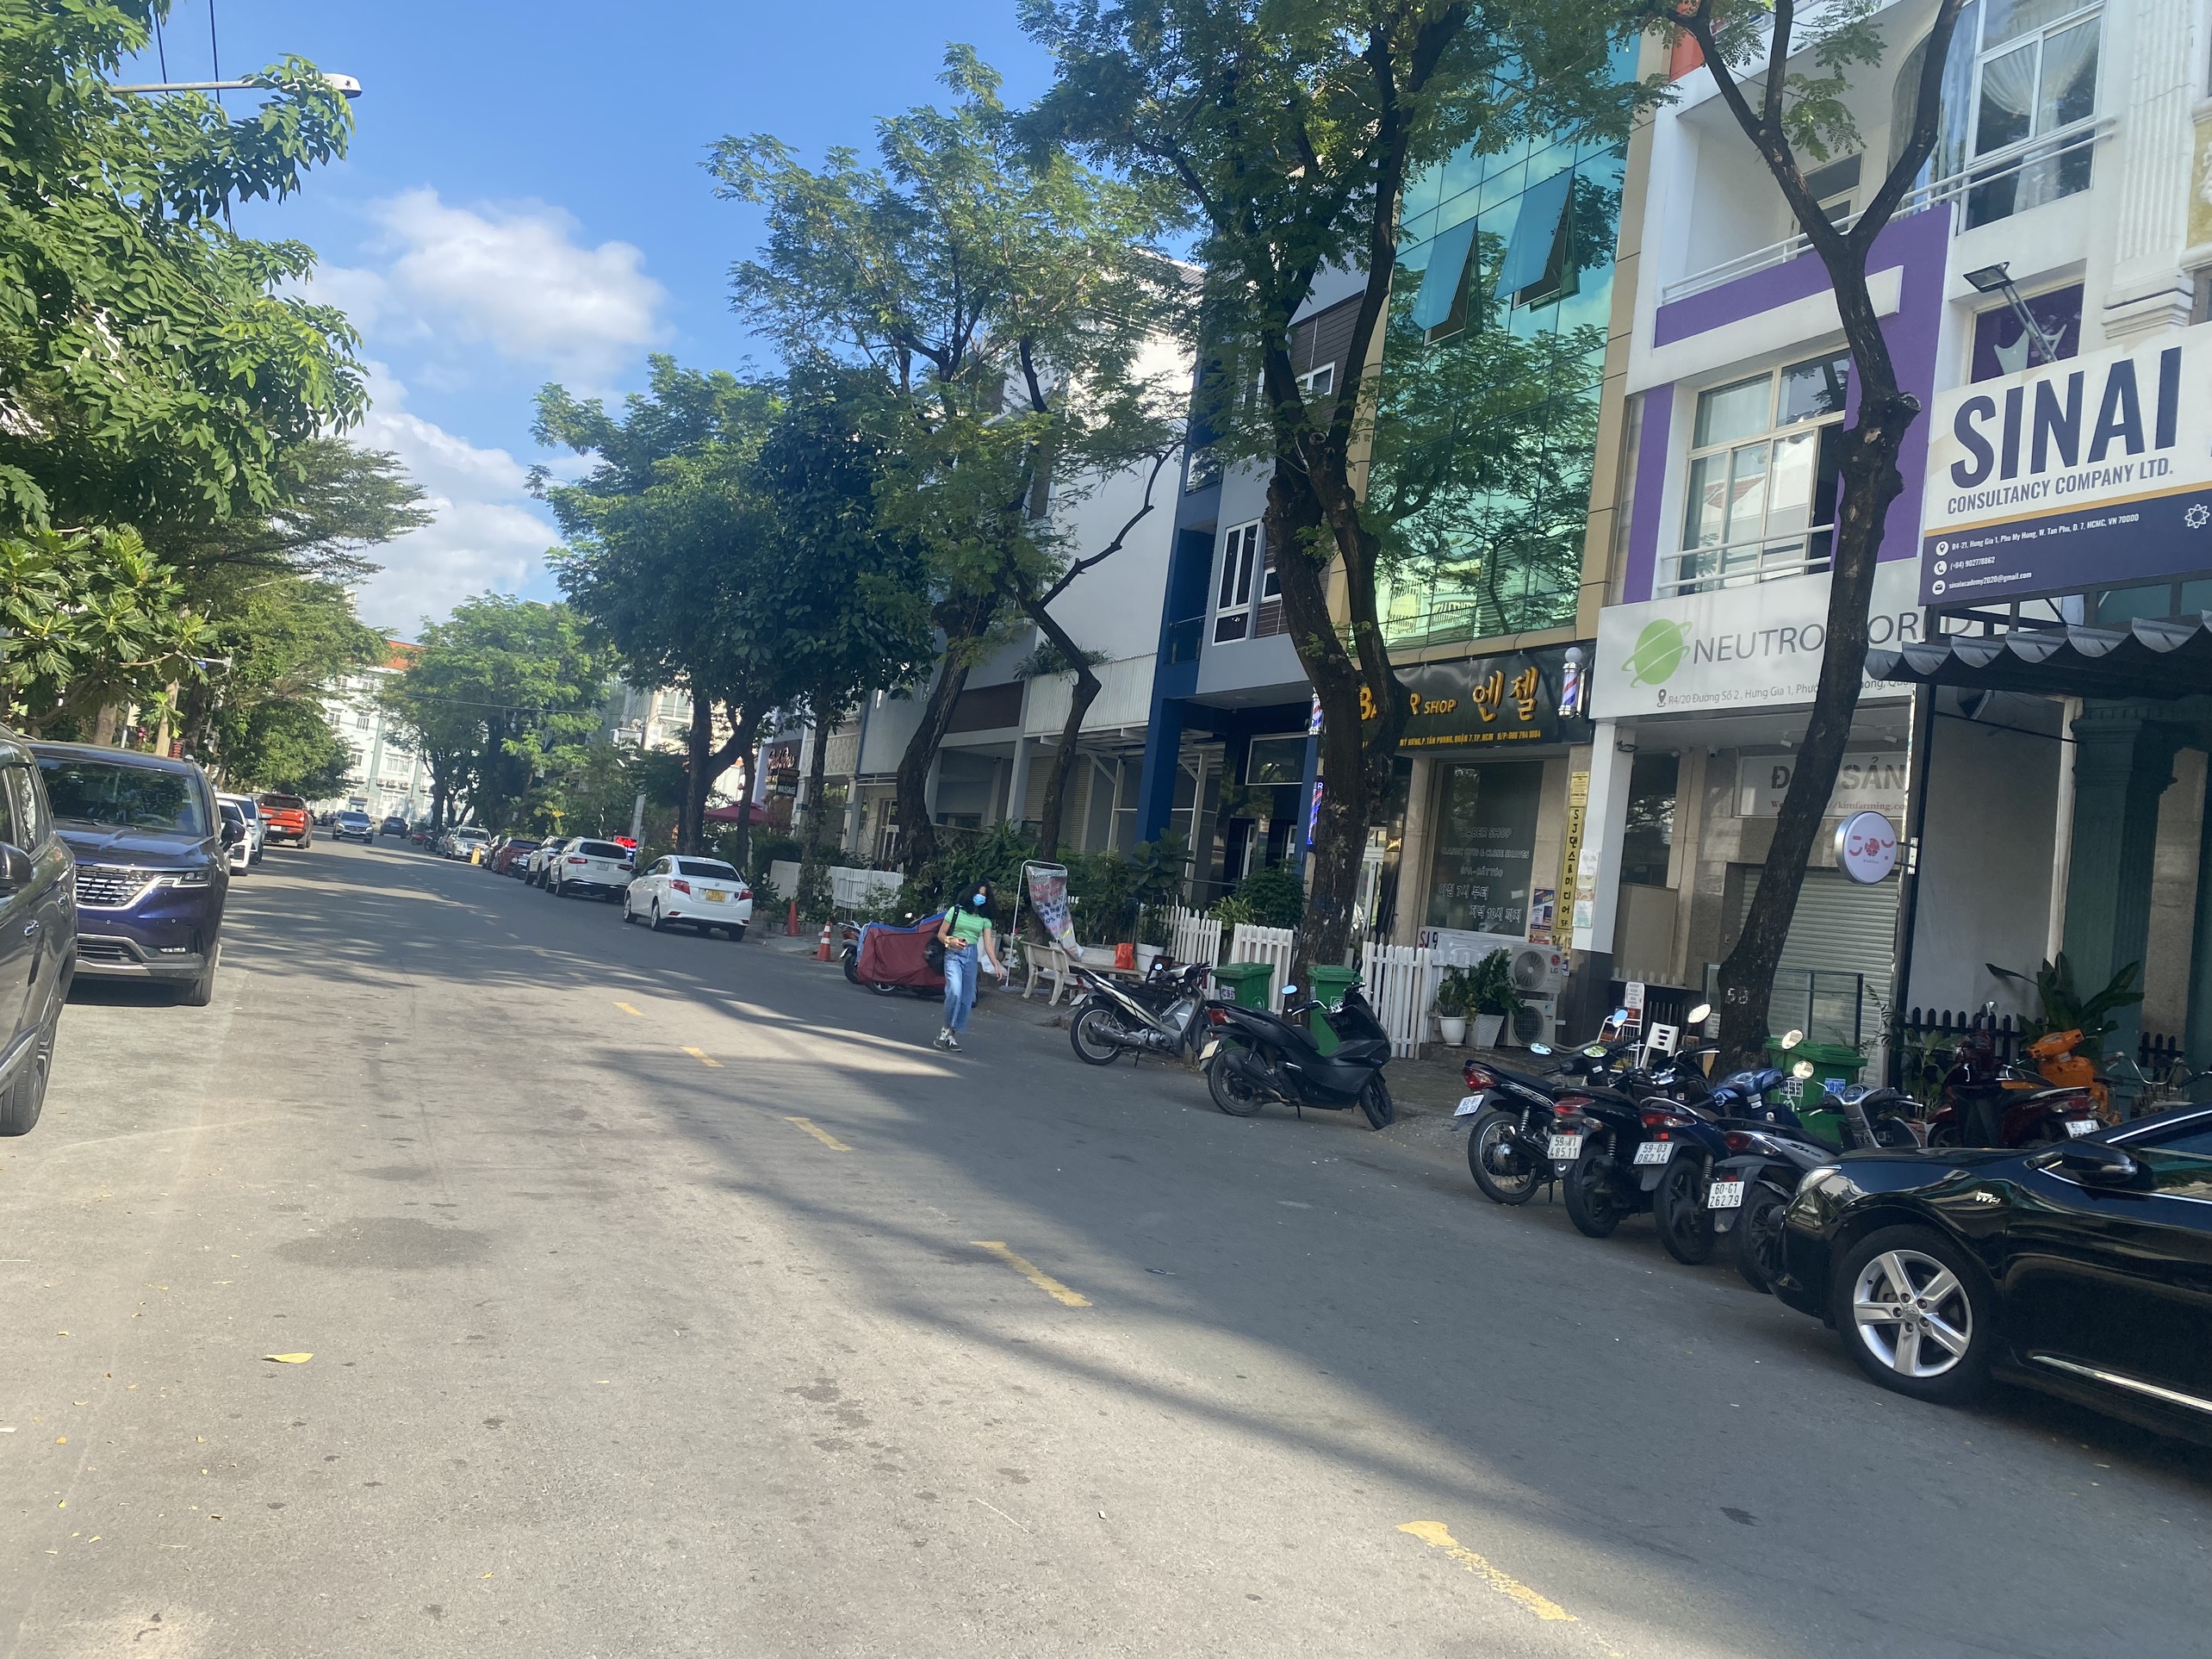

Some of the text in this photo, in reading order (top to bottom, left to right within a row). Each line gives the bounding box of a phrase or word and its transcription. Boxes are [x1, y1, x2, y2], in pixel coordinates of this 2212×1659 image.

[1950, 346, 2183, 489] SINAI
[1948, 457, 2173, 515] CONSULTANCY COMPANY LTD.
[2012, 532, 2021, 542] My
[2109, 517, 2117, 525] VN
[1668, 694, 1692, 705] R4/20
[1722, 689, 1732, 701] Số
[1745, 688, 1768, 699] Hưng
[1770, 687, 1785, 697] Gia
[1424, 699, 1457, 714] SHOP
[1461, 827, 1512, 839] BABER SHOP
[1550, 1147, 1578, 1158] 485.11
[1643, 1144, 1668, 1153] 59-D3
[1637, 1153, 1666, 1163] 082.14
[1714, 1184, 1737, 1195] 60-G1
[1710, 1195, 1740, 1208] 262.79
